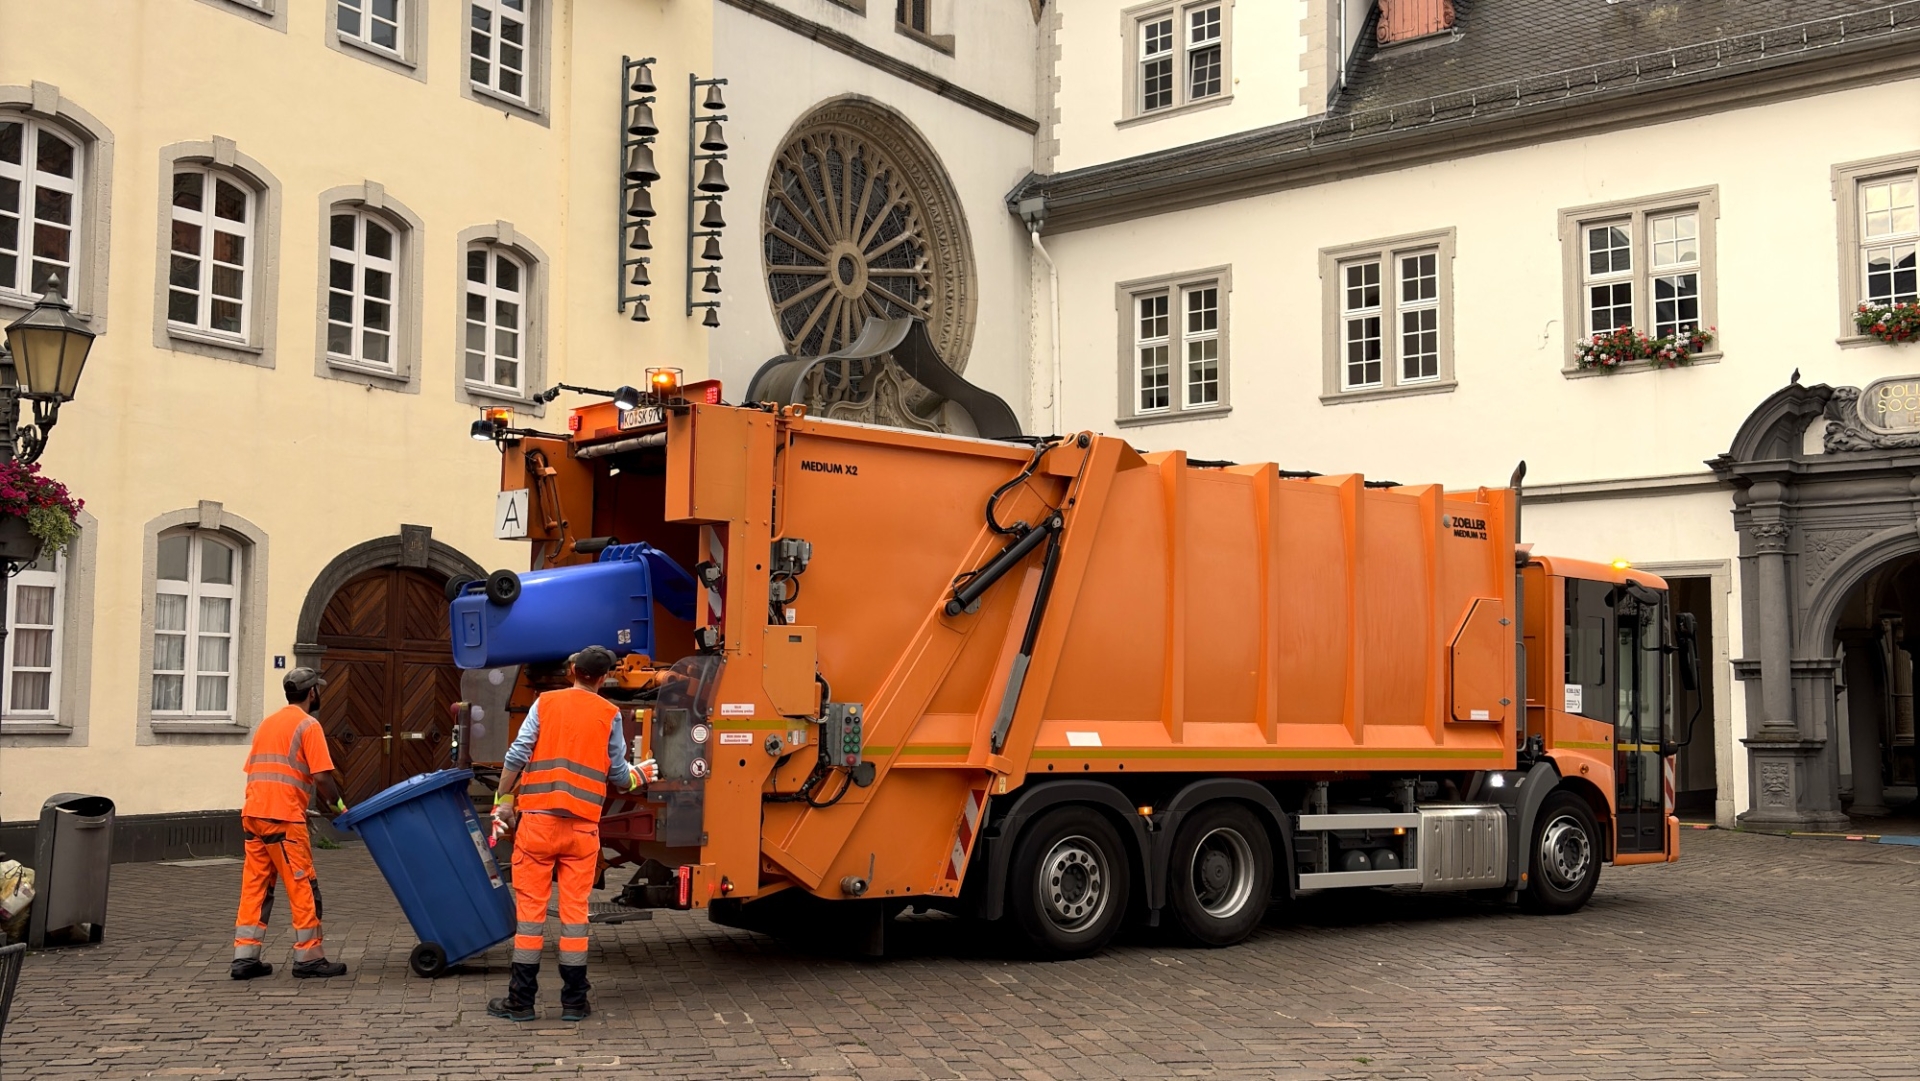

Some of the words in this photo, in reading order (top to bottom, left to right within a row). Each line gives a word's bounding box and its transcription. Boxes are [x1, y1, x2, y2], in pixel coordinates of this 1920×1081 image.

[1877, 397, 1920, 413] SOC
[624, 411, 634, 427] KO
[638, 409, 647, 424] SK
[801, 460, 843, 475] MEDIUM
[845, 464, 858, 476] X2
[501, 497, 520, 531] A
[1452, 516, 1486, 531] ZOELLER
[1453, 529, 1478, 539] MEDIUM
[1479, 531, 1487, 541] X2
